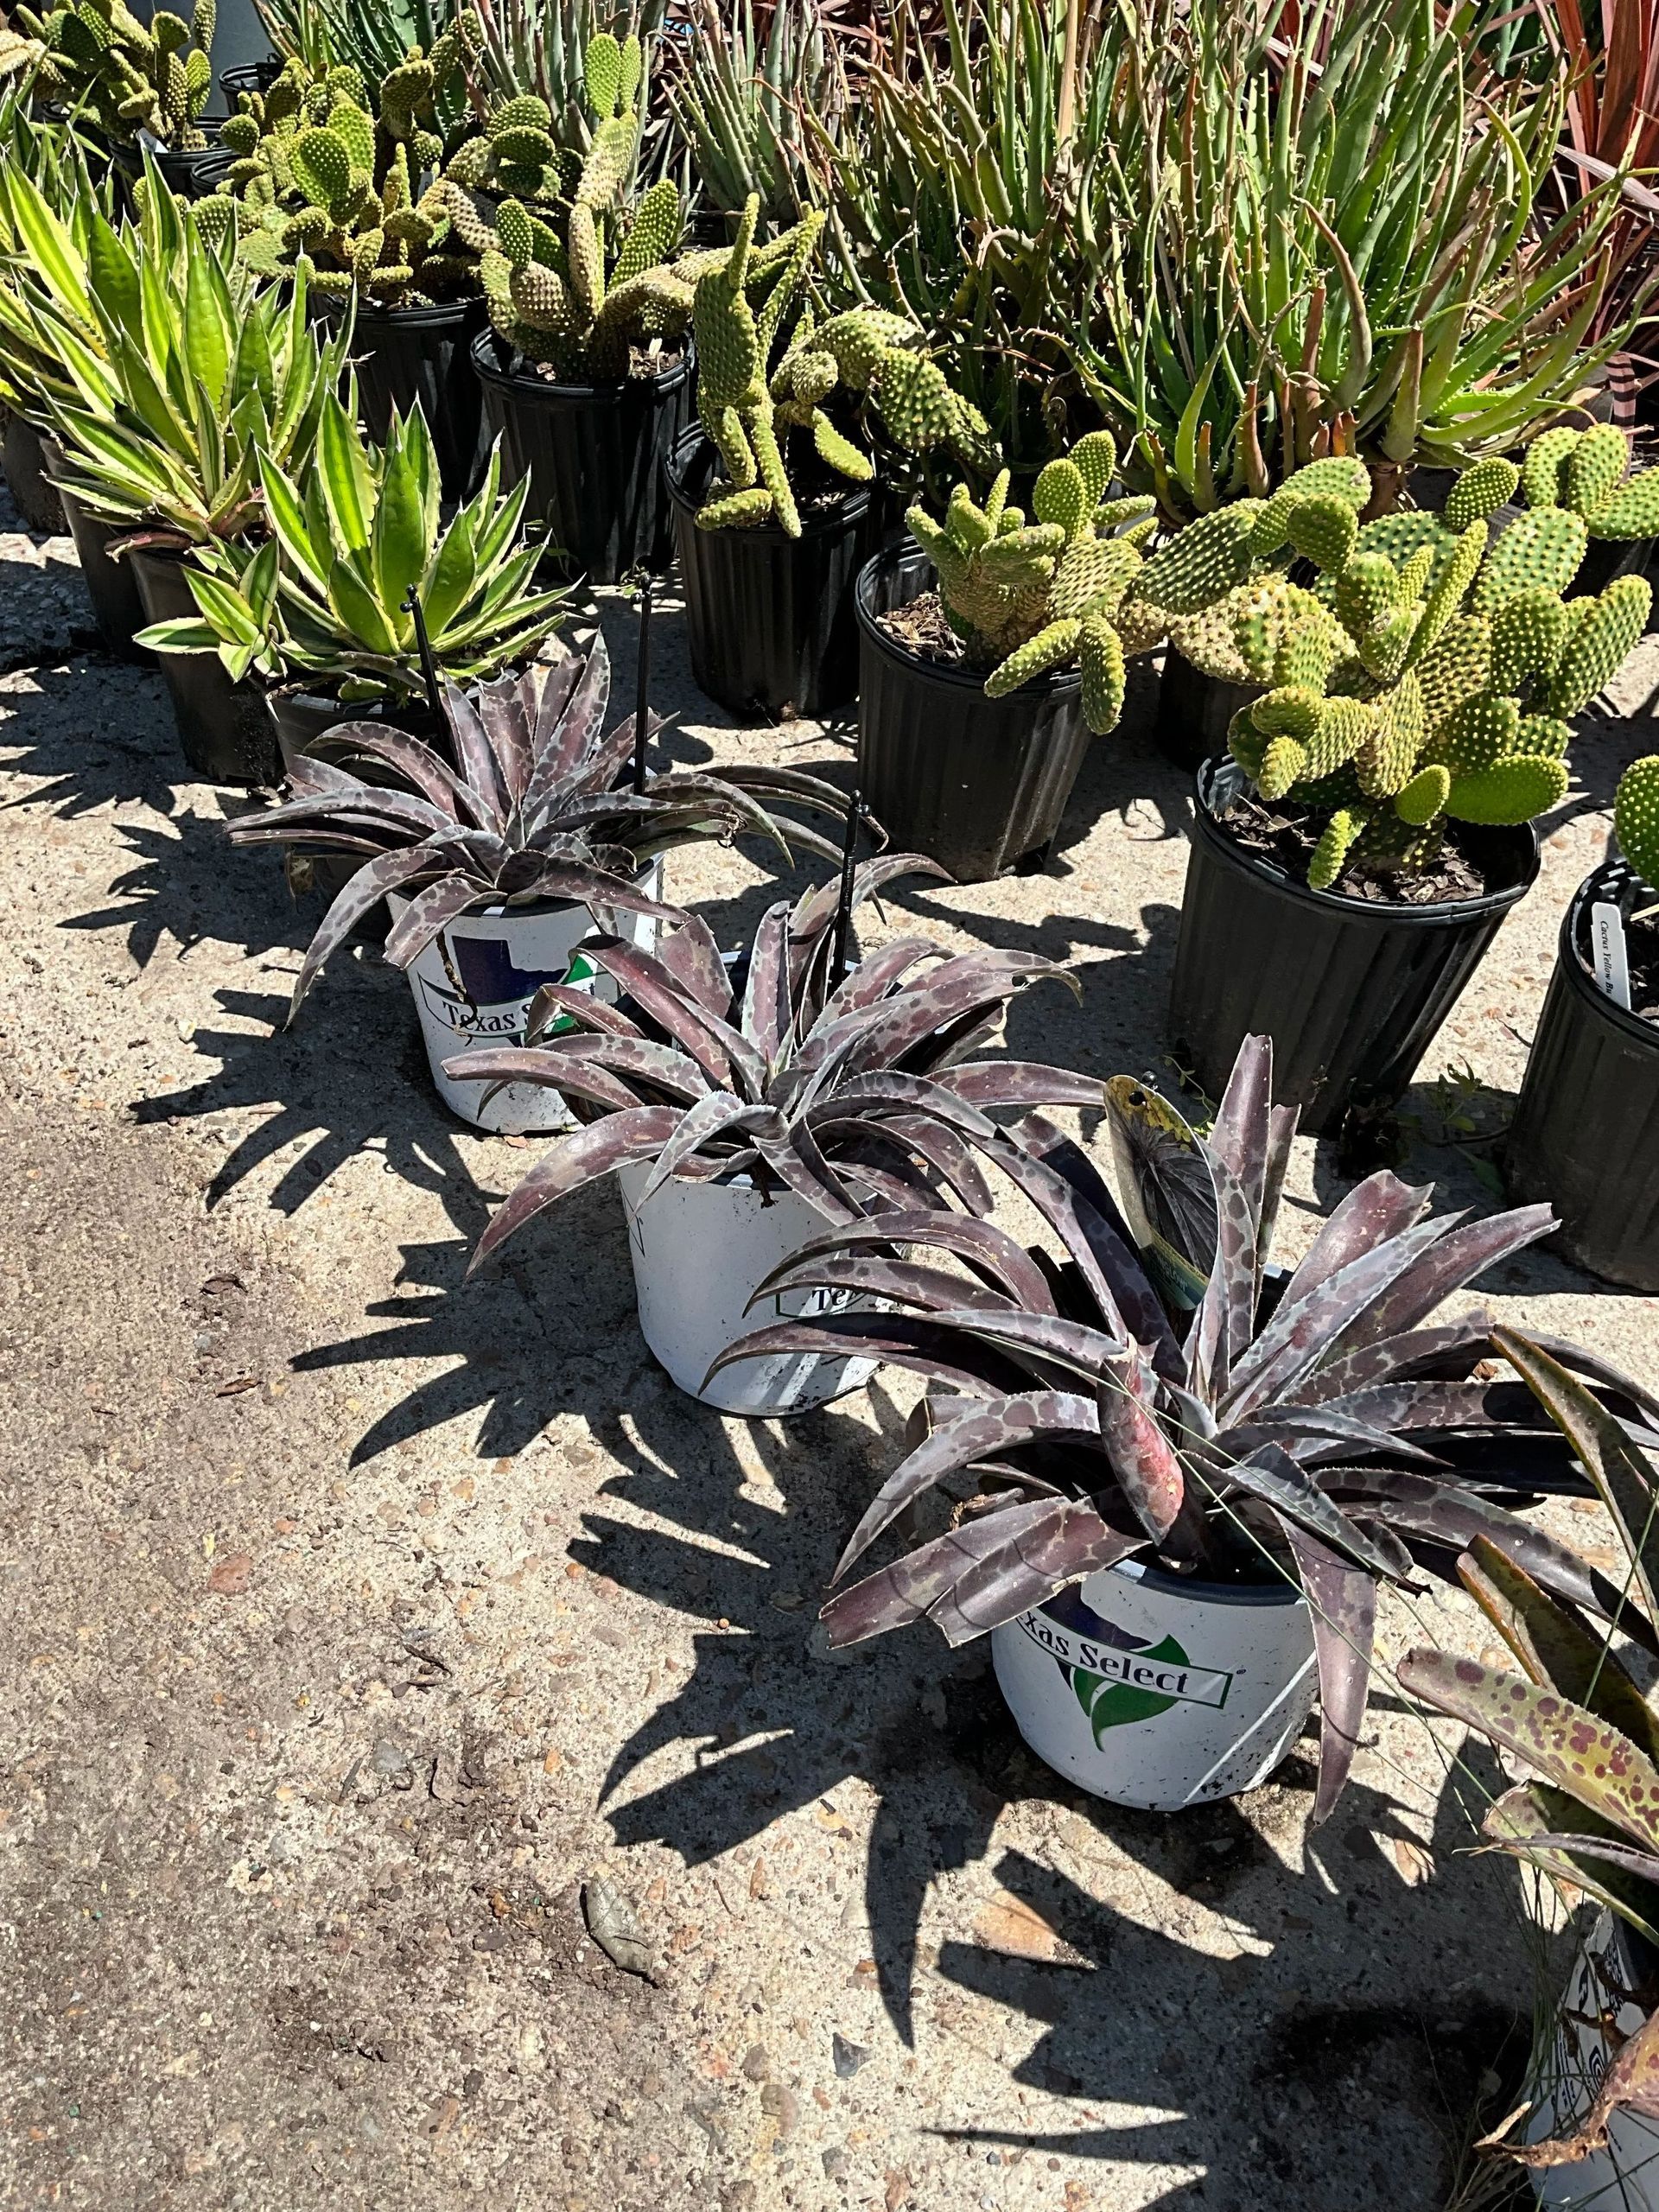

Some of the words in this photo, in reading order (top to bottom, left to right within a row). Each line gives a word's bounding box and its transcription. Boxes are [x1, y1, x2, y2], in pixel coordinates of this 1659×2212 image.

[1603, 952, 1612, 981] Yellow
[442, 1000, 517, 1033] Texas
[1017, 1610, 1070, 1656] xas
[1079, 1643, 1189, 1694] Select
